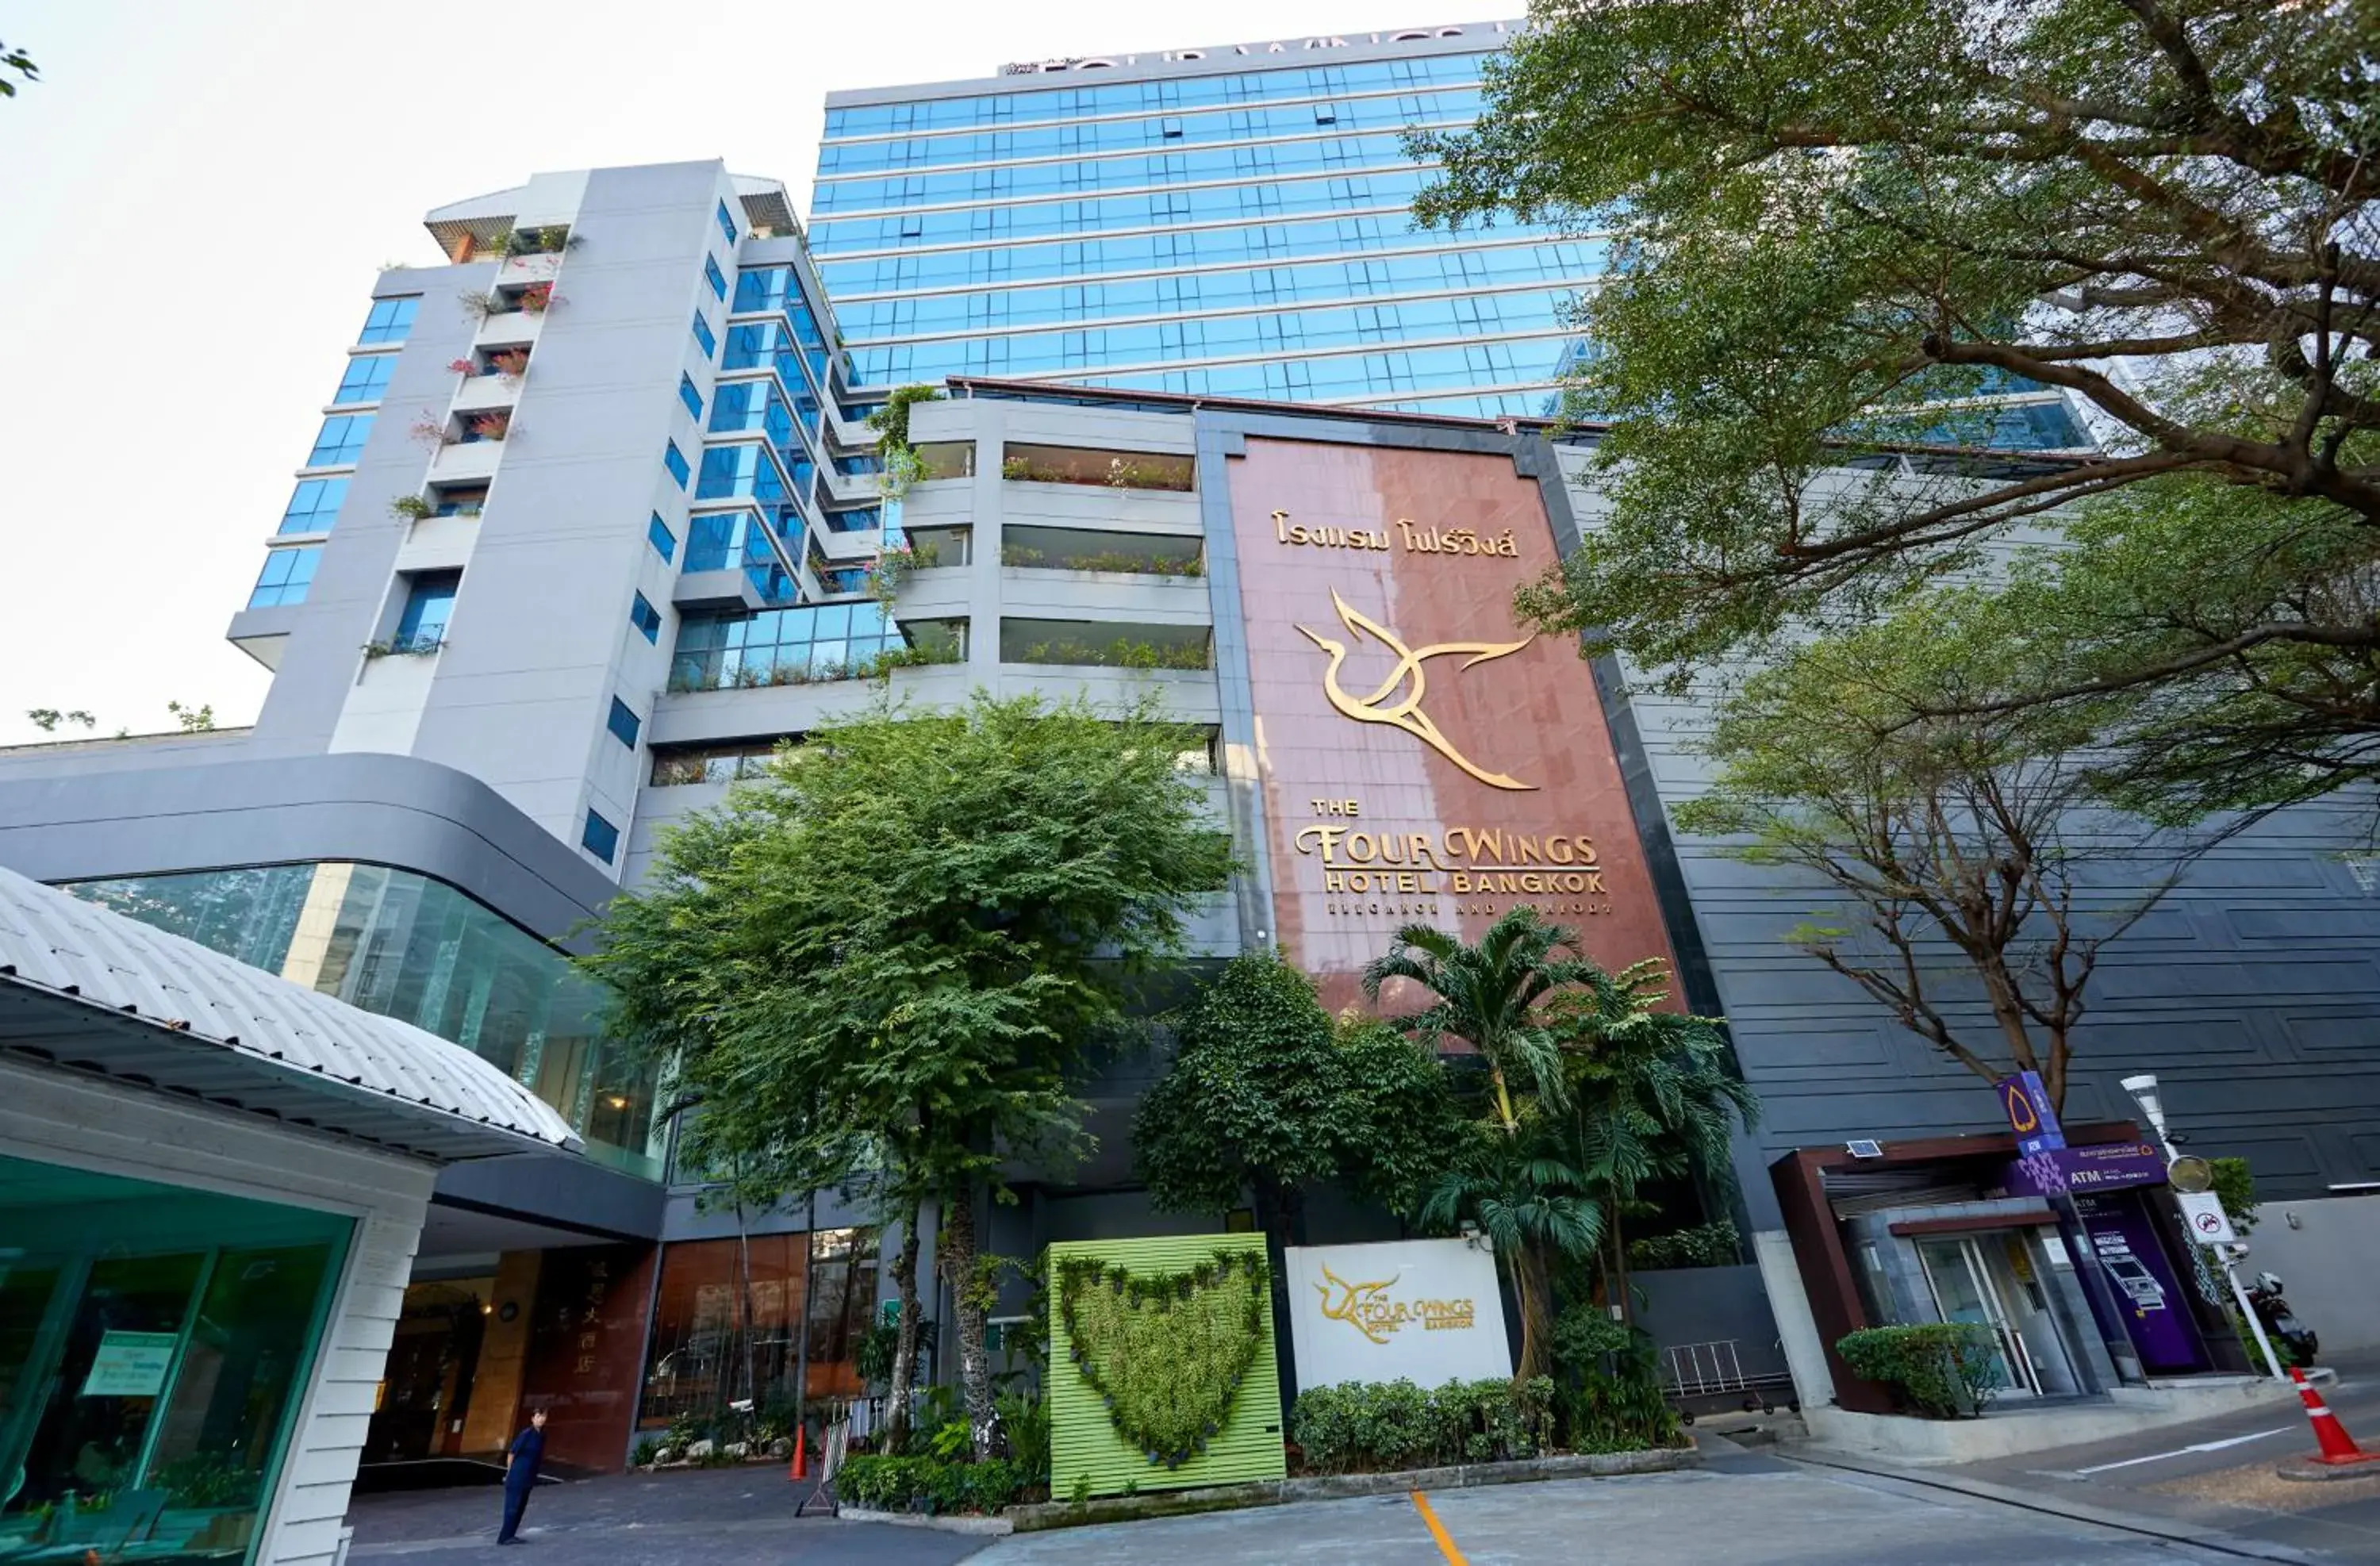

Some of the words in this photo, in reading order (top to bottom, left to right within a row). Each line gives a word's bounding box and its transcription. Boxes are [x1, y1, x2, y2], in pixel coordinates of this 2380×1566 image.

[1271, 509, 1391, 551] โรงแรม
[1395, 518, 1520, 558] โฟร์วิงส์
[1311, 799, 1359, 816] THE
[1295, 824, 1461, 871] FOUR
[1443, 827, 1599, 865] WINGS
[1325, 873, 1437, 893] HOTEL
[1453, 873, 1606, 893] BANGKOK
[2071, 1170, 2102, 1185] ATM
[1357, 1302, 1417, 1322] FOUR
